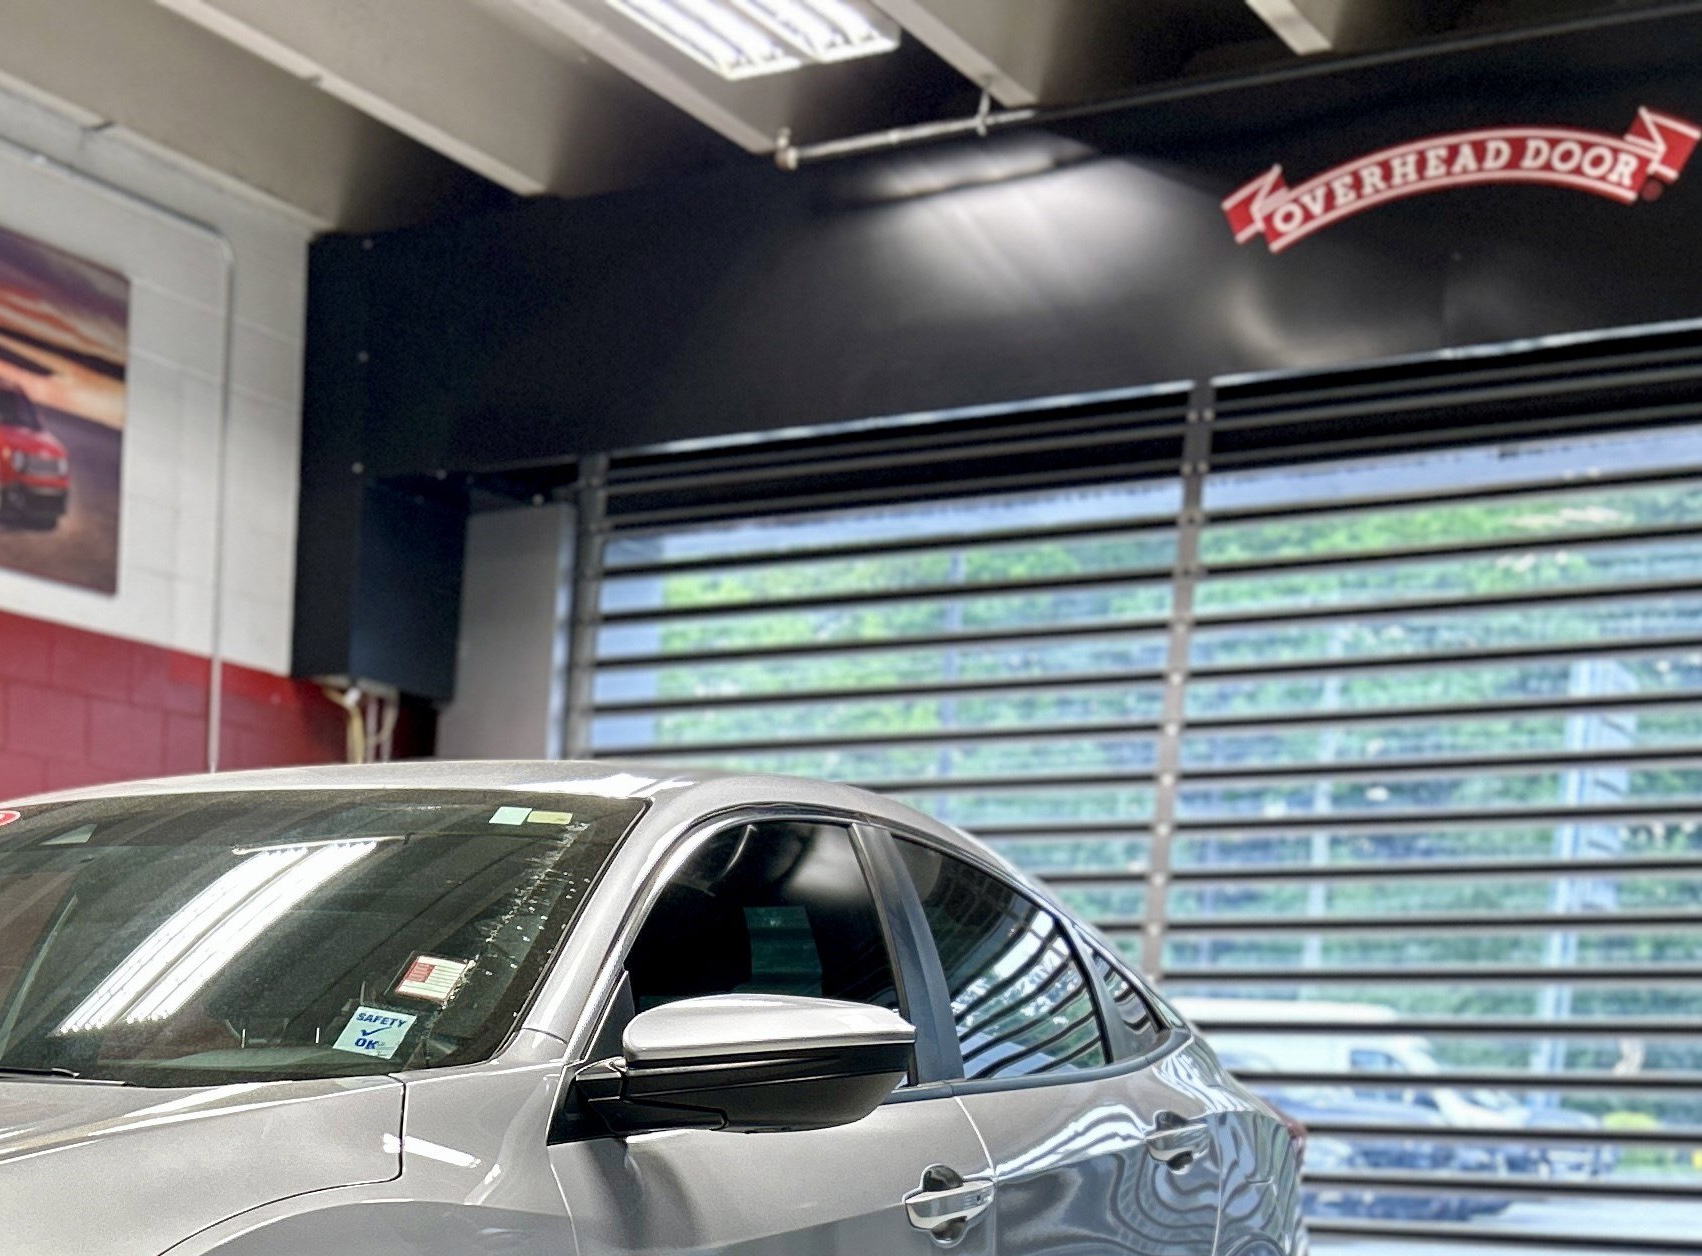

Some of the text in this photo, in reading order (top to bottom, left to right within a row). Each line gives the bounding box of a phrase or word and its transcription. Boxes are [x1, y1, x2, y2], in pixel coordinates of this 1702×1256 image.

[1271, 138, 1639, 234] OVERHEAD DOOR
[356, 1012, 407, 1028] SAFETY
[354, 1038, 379, 1050] OK
